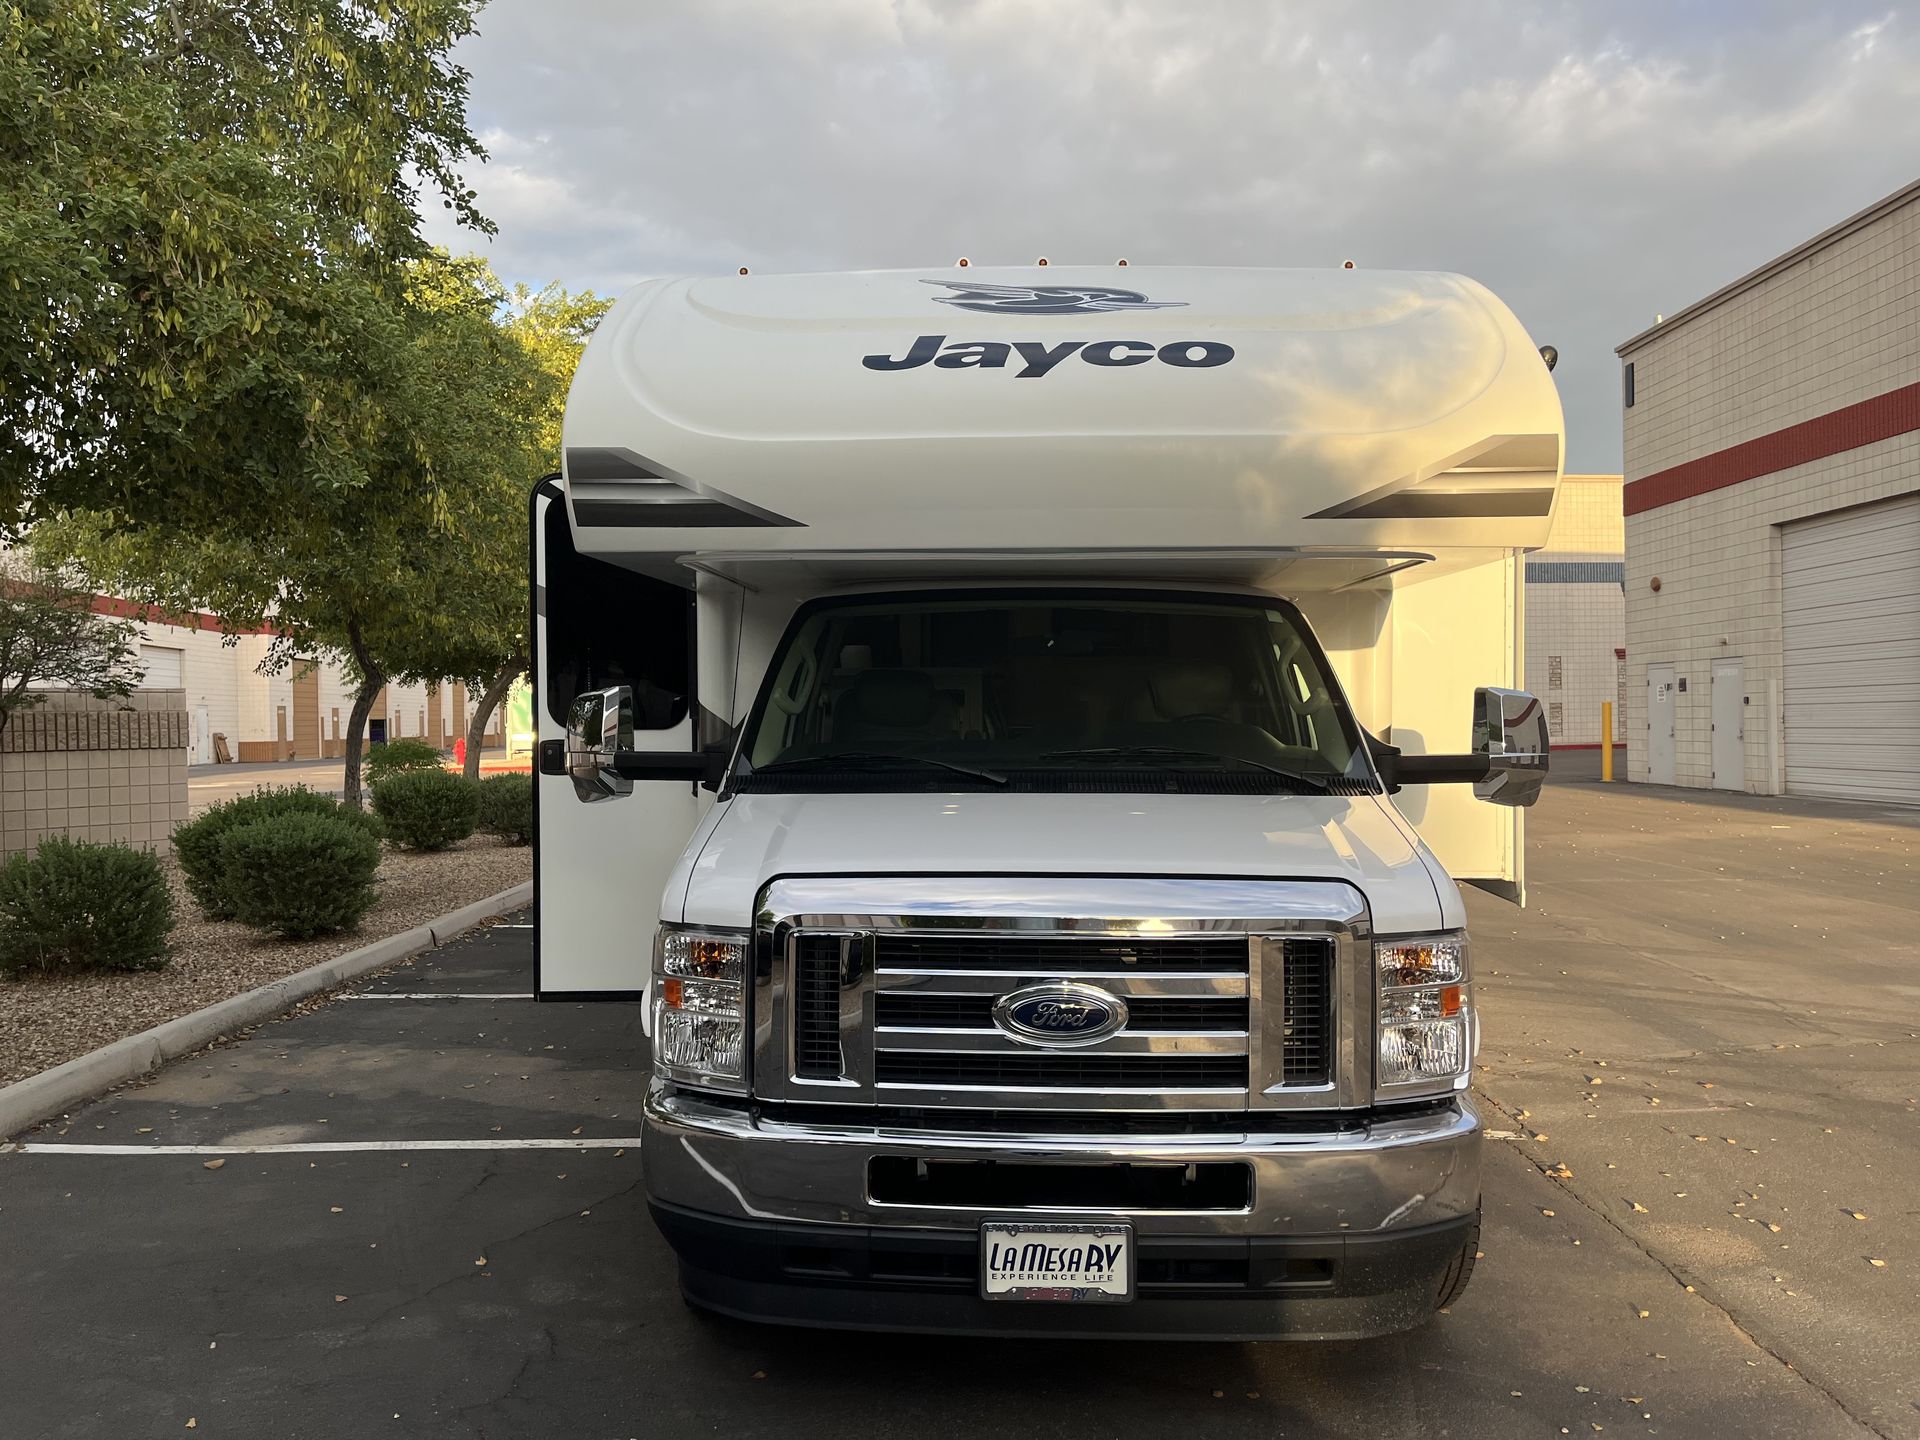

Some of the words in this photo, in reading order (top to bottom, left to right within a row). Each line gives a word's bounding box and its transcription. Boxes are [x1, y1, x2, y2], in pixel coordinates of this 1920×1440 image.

[862, 335, 1235, 378] Jayco
[1031, 1001, 1089, 1026] Ford
[991, 1273, 1077, 1281] EXPERIENCE
